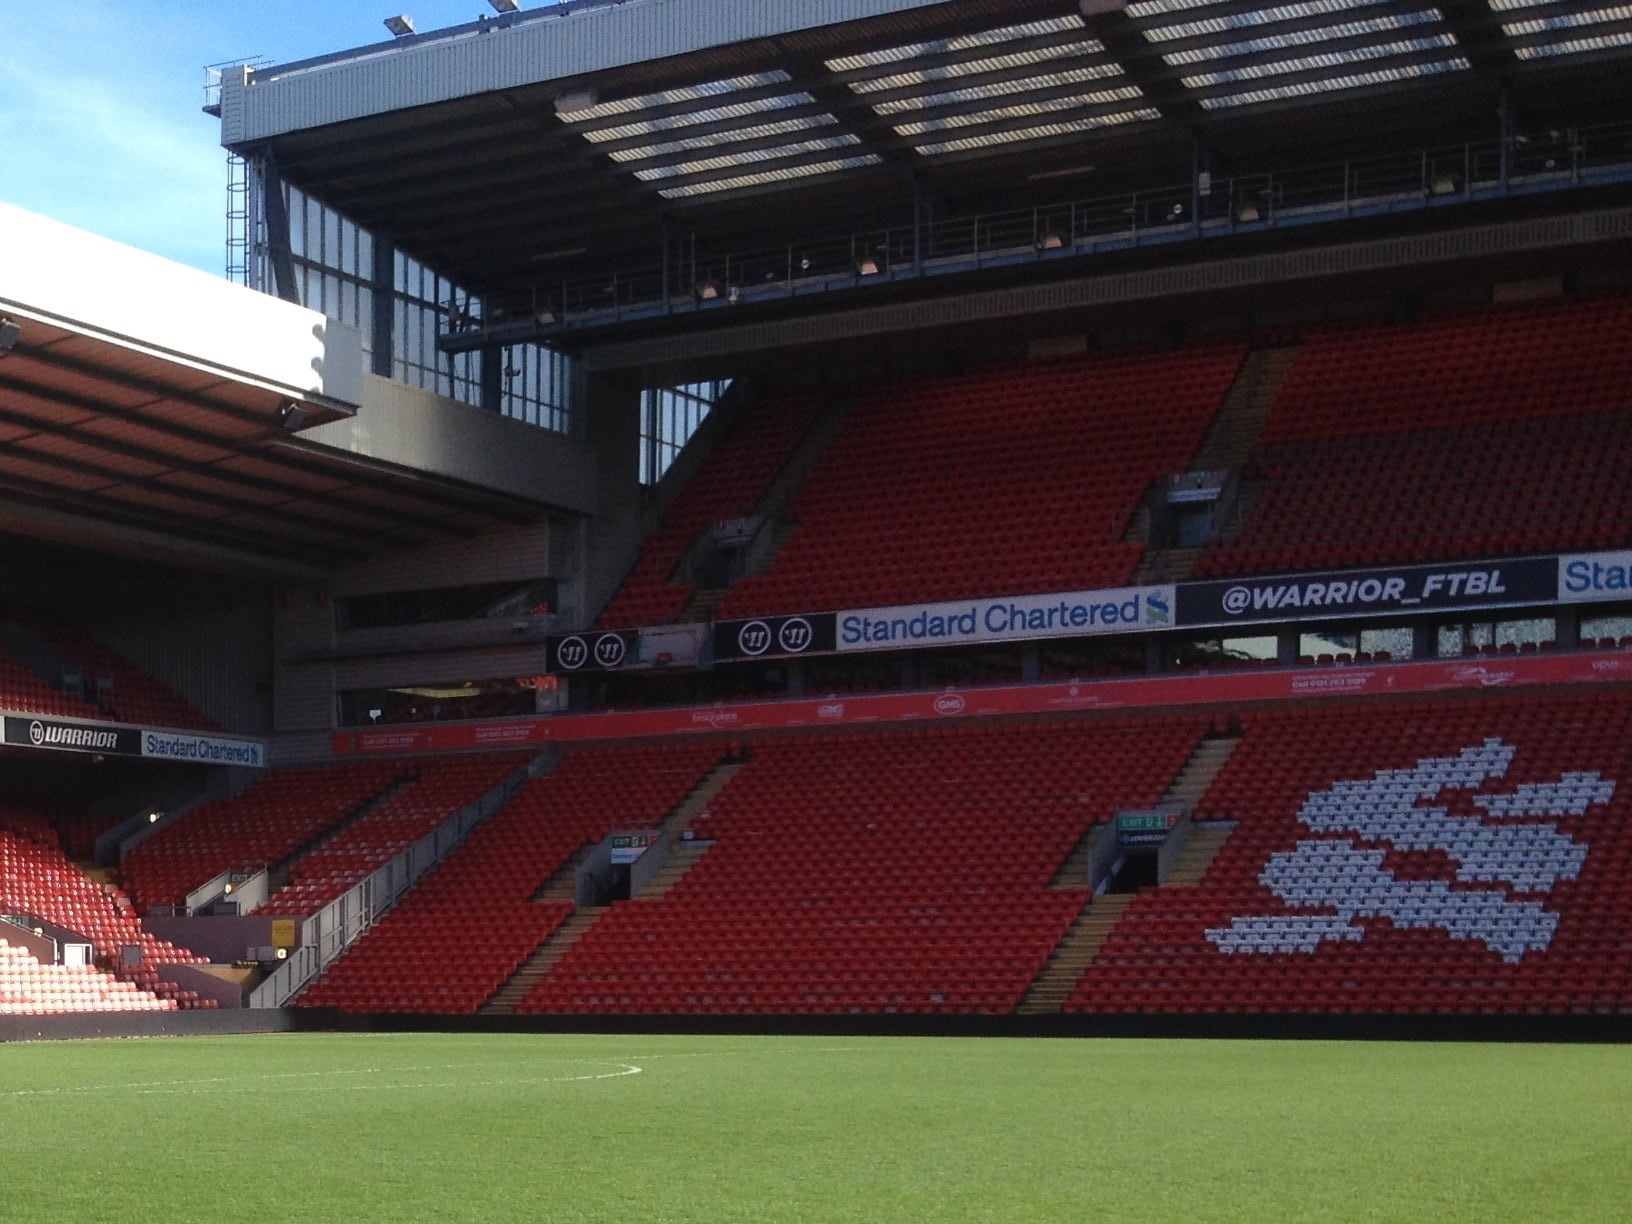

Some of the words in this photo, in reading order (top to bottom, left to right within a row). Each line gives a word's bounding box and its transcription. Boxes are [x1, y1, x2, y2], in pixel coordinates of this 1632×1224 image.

[1565, 560, 1632, 592] Sta
[1222, 571, 1506, 614] @WARRIOR_FTBL
[842, 608, 977, 645] Standard
[984, 595, 1140, 633] Chartered
[45, 727, 118, 749] WARRIOR
[146, 735, 197, 758] Standard
[198, 739, 250, 763] Chartered
